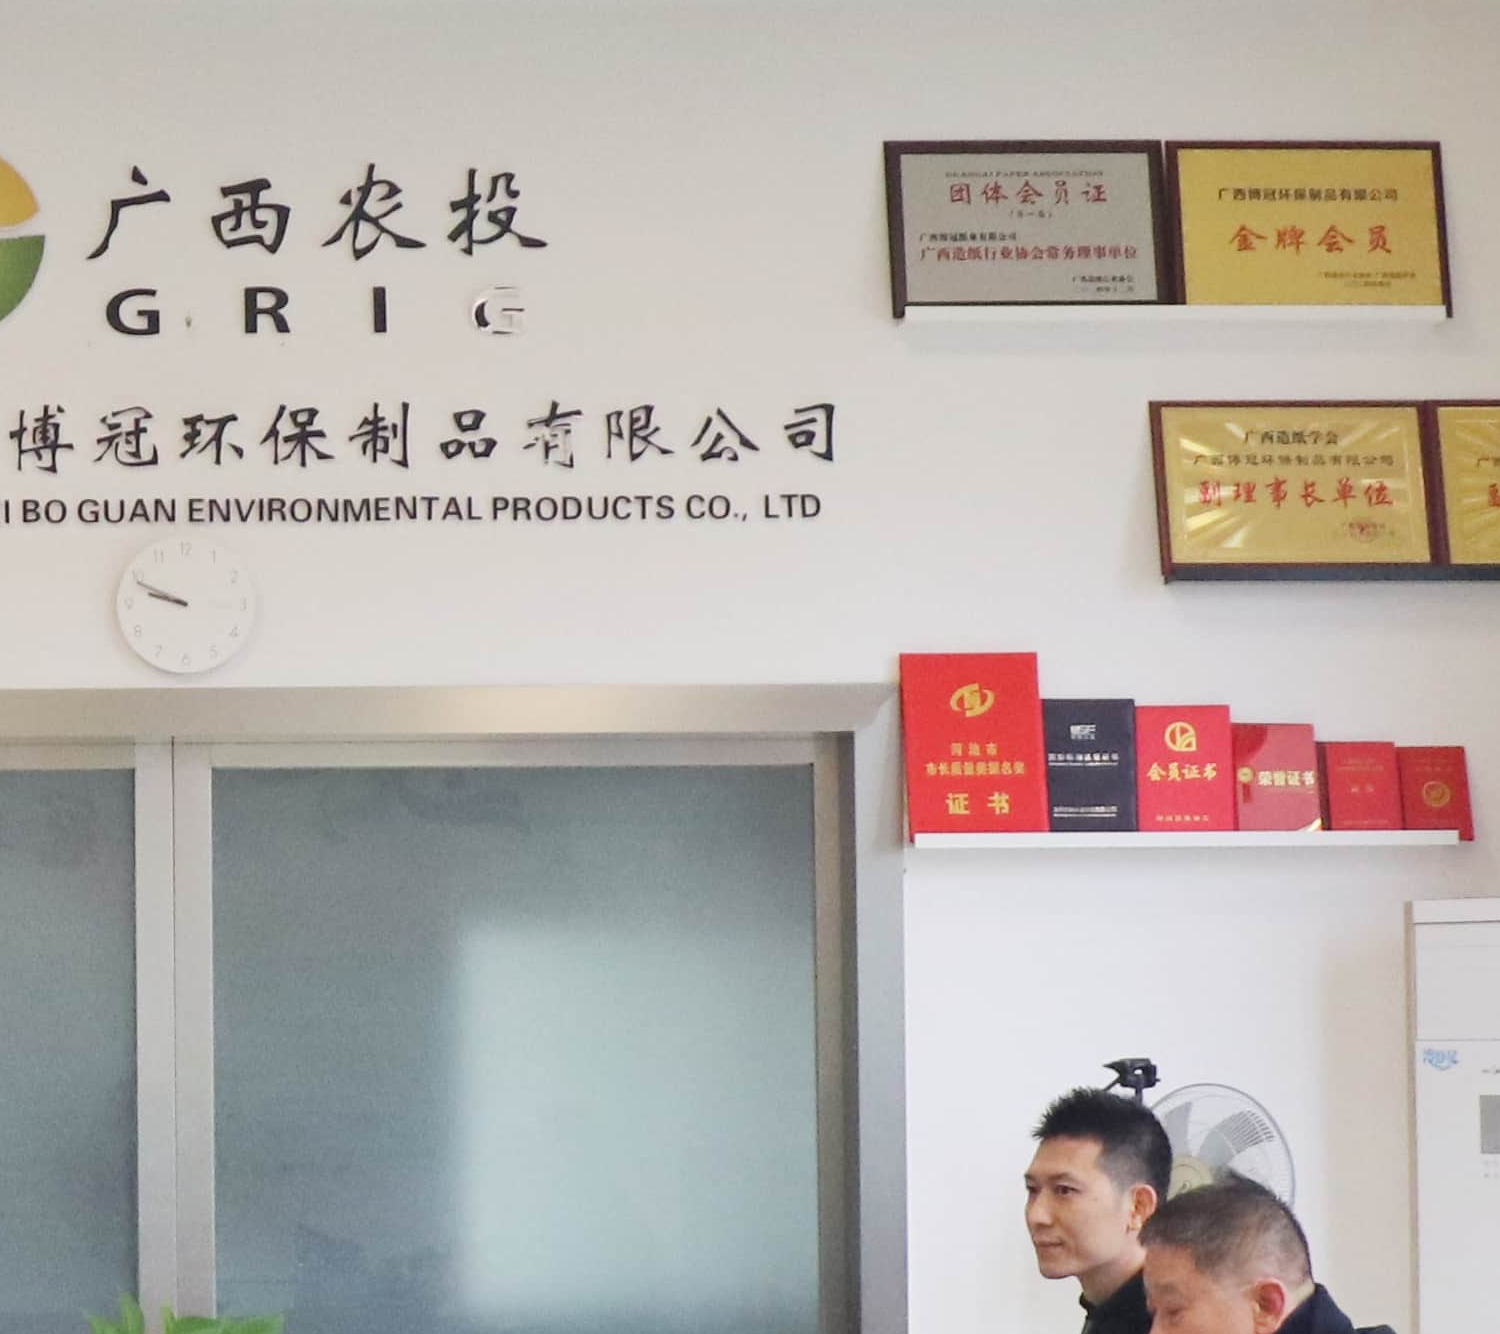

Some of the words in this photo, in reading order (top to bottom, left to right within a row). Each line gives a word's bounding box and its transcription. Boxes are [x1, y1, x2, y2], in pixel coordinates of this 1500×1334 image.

[949, 180, 1108, 206] 团体会员证
[86, 163, 548, 262] 广西农投
[1228, 223, 1394, 255] 金牌会员
[1198, 476, 1395, 511] 副理事长单位
[22, 499, 68, 525] BO
[77, 498, 176, 525] GUAN
[188, 496, 482, 524] ENVIRONMENTAL
[491, 495, 675, 523] PRODUCTS
[685, 494, 748, 522] CO.,
[763, 493, 822, 520] LTD
[1147, 762, 1218, 781] 会员证书
[1257, 770, 1317, 787] 荣誉证书
[945, 792, 1013, 816] 证书
